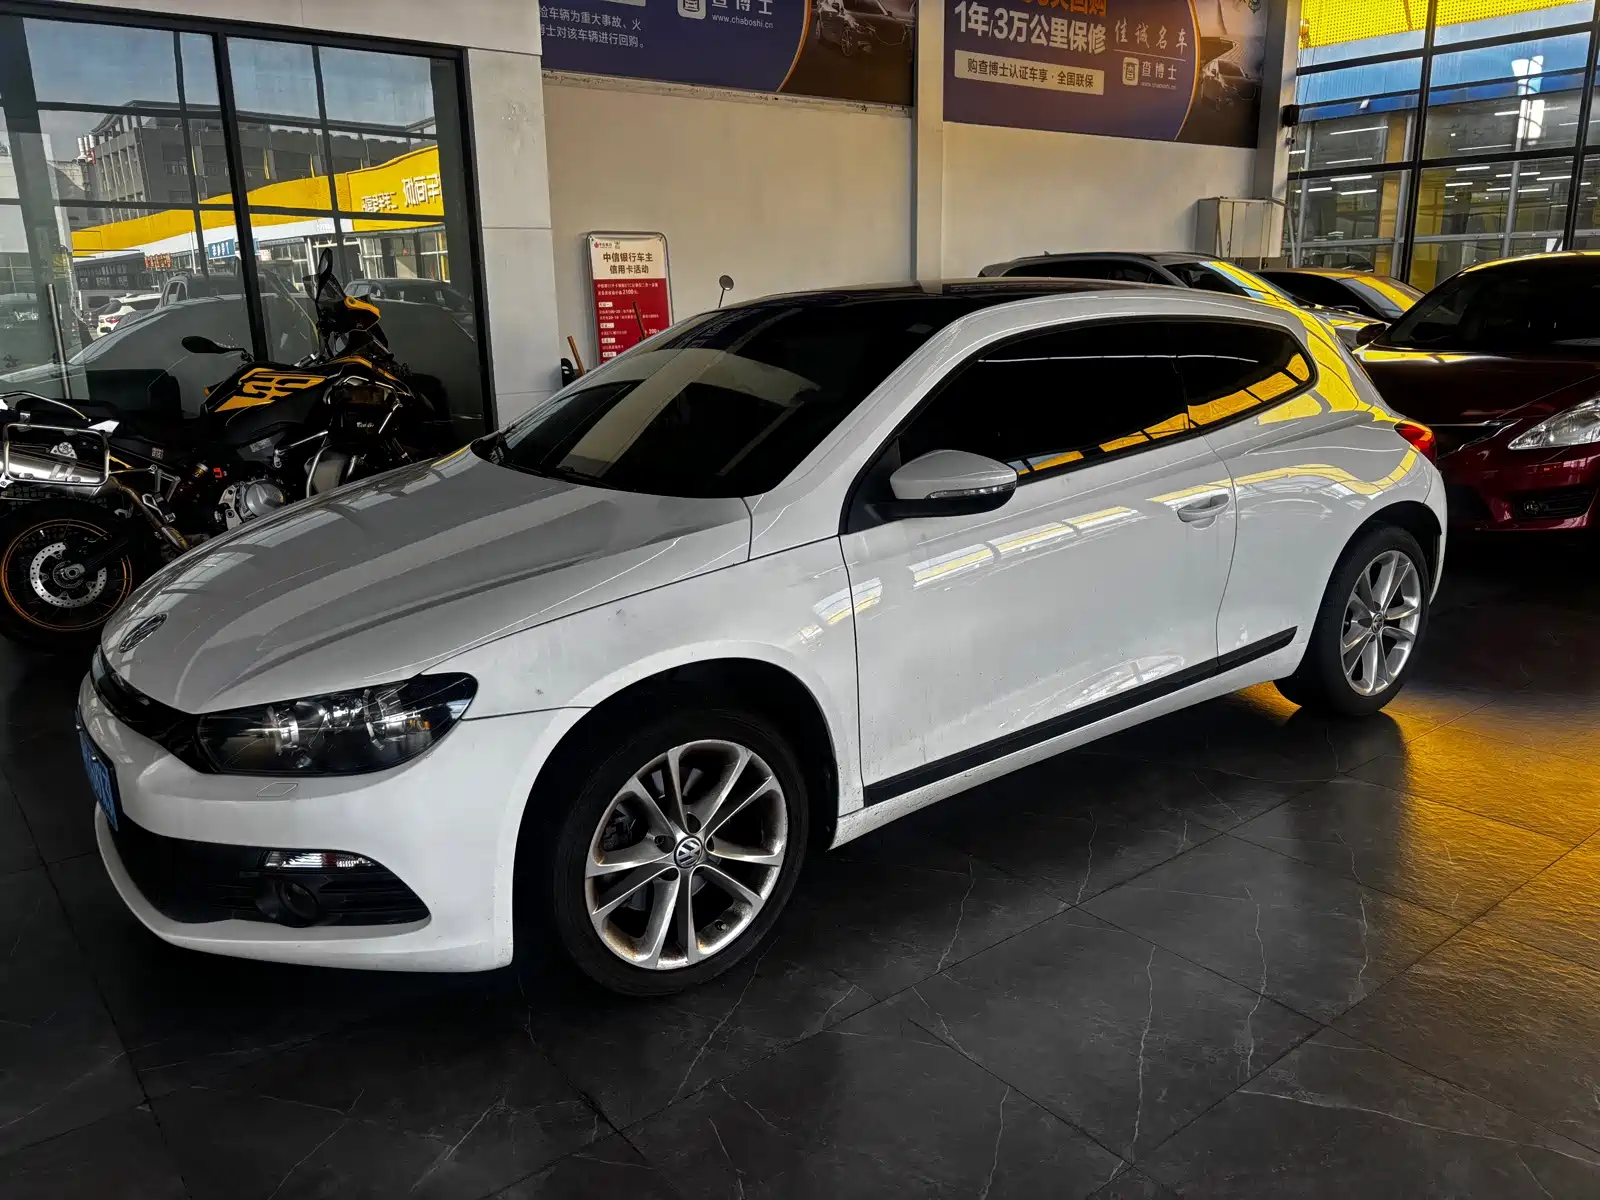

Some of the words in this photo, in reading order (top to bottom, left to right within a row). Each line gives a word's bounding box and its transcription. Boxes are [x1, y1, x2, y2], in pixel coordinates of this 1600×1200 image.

[711, 13, 774, 29] www.chaboshi.cn
[954, 1, 1107, 55] 1年/3万公里保修
[1141, 61, 1178, 81] 查博士
[602, 252, 653, 263] 中信银行车主
[609, 264, 649, 275] 信用卡活动
